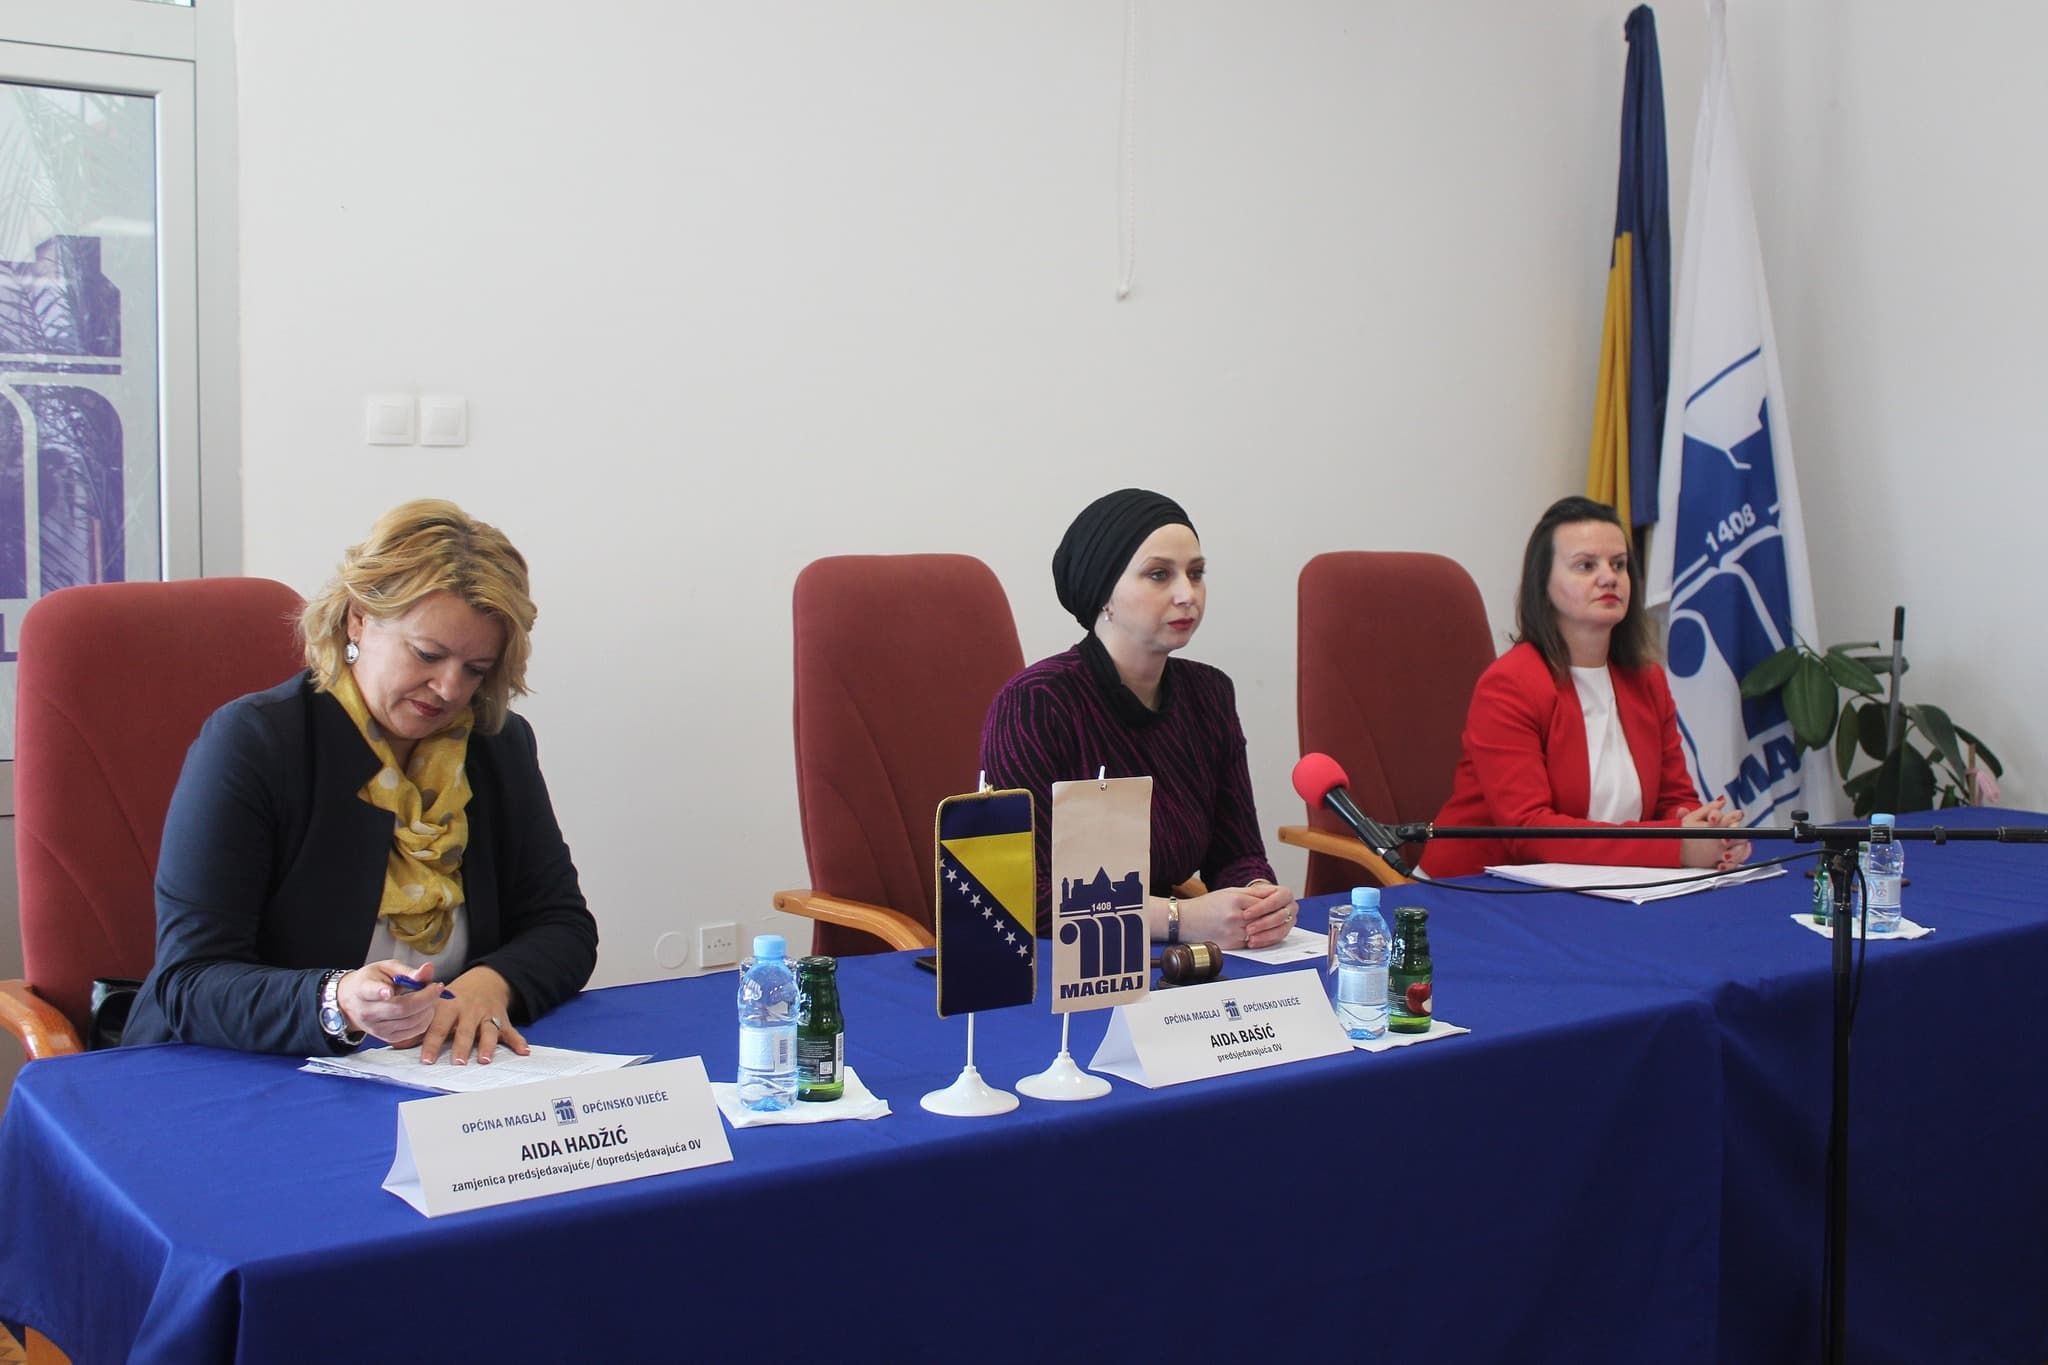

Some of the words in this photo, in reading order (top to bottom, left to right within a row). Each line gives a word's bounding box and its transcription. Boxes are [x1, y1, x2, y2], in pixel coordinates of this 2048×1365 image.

[1706, 503, 1756, 552] 1408
[1091, 901, 1112, 912] 1408
[1060, 975, 1143, 999] MAGLAJ
[1192, 1009, 1220, 1021] MAGLAJ
[1210, 1032, 1240, 1048] AIDA
[1238, 1022, 1276, 1043] BAŠIĆ
[1272, 1043, 1282, 1052] OV
[462, 1118, 503, 1134] OPĆINA
[504, 1111, 546, 1127] MAGLAJ
[582, 1096, 634, 1114] OPĆINSKO
[634, 1089, 669, 1106] VIJEĆE
[521, 1140, 563, 1161] AIDA
[564, 1124, 628, 1154] HADŽIĆ
[452, 1174, 506, 1192] zamjenica
[688, 1139, 702, 1151] OV
